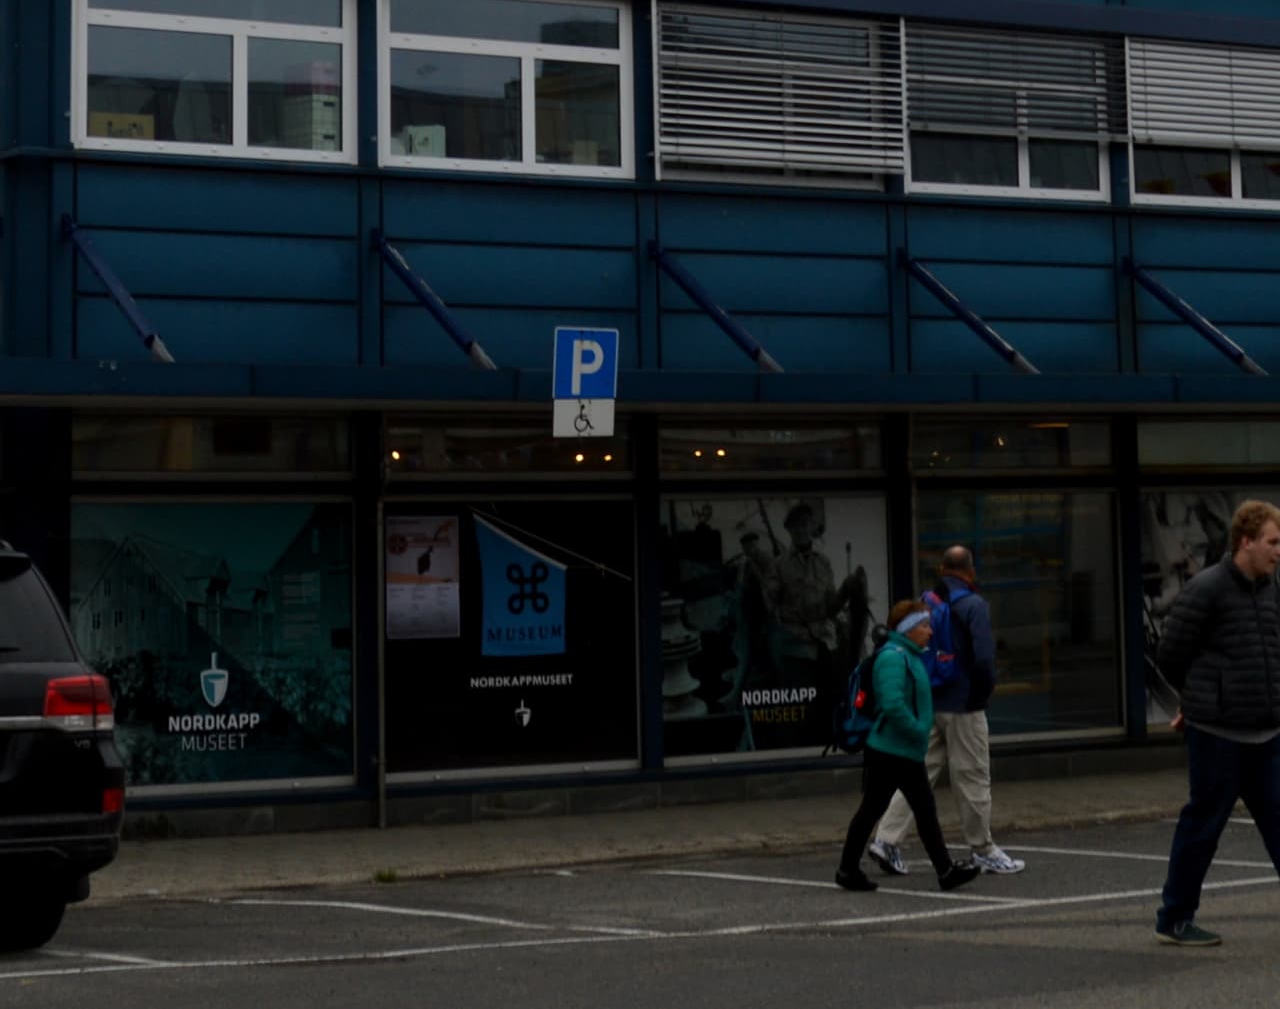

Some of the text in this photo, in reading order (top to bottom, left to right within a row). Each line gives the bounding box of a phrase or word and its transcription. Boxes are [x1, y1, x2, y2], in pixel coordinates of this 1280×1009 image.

[571, 339, 604, 396] P
[487, 625, 562, 641] MUSEUM
[470, 674, 573, 688] NORDKAPPMUSEET
[742, 687, 817, 706] NORDKAPP
[168, 713, 260, 732] NORDKAPP
[752, 705, 806, 723] MUSEET
[181, 733, 247, 751] MUSEET
